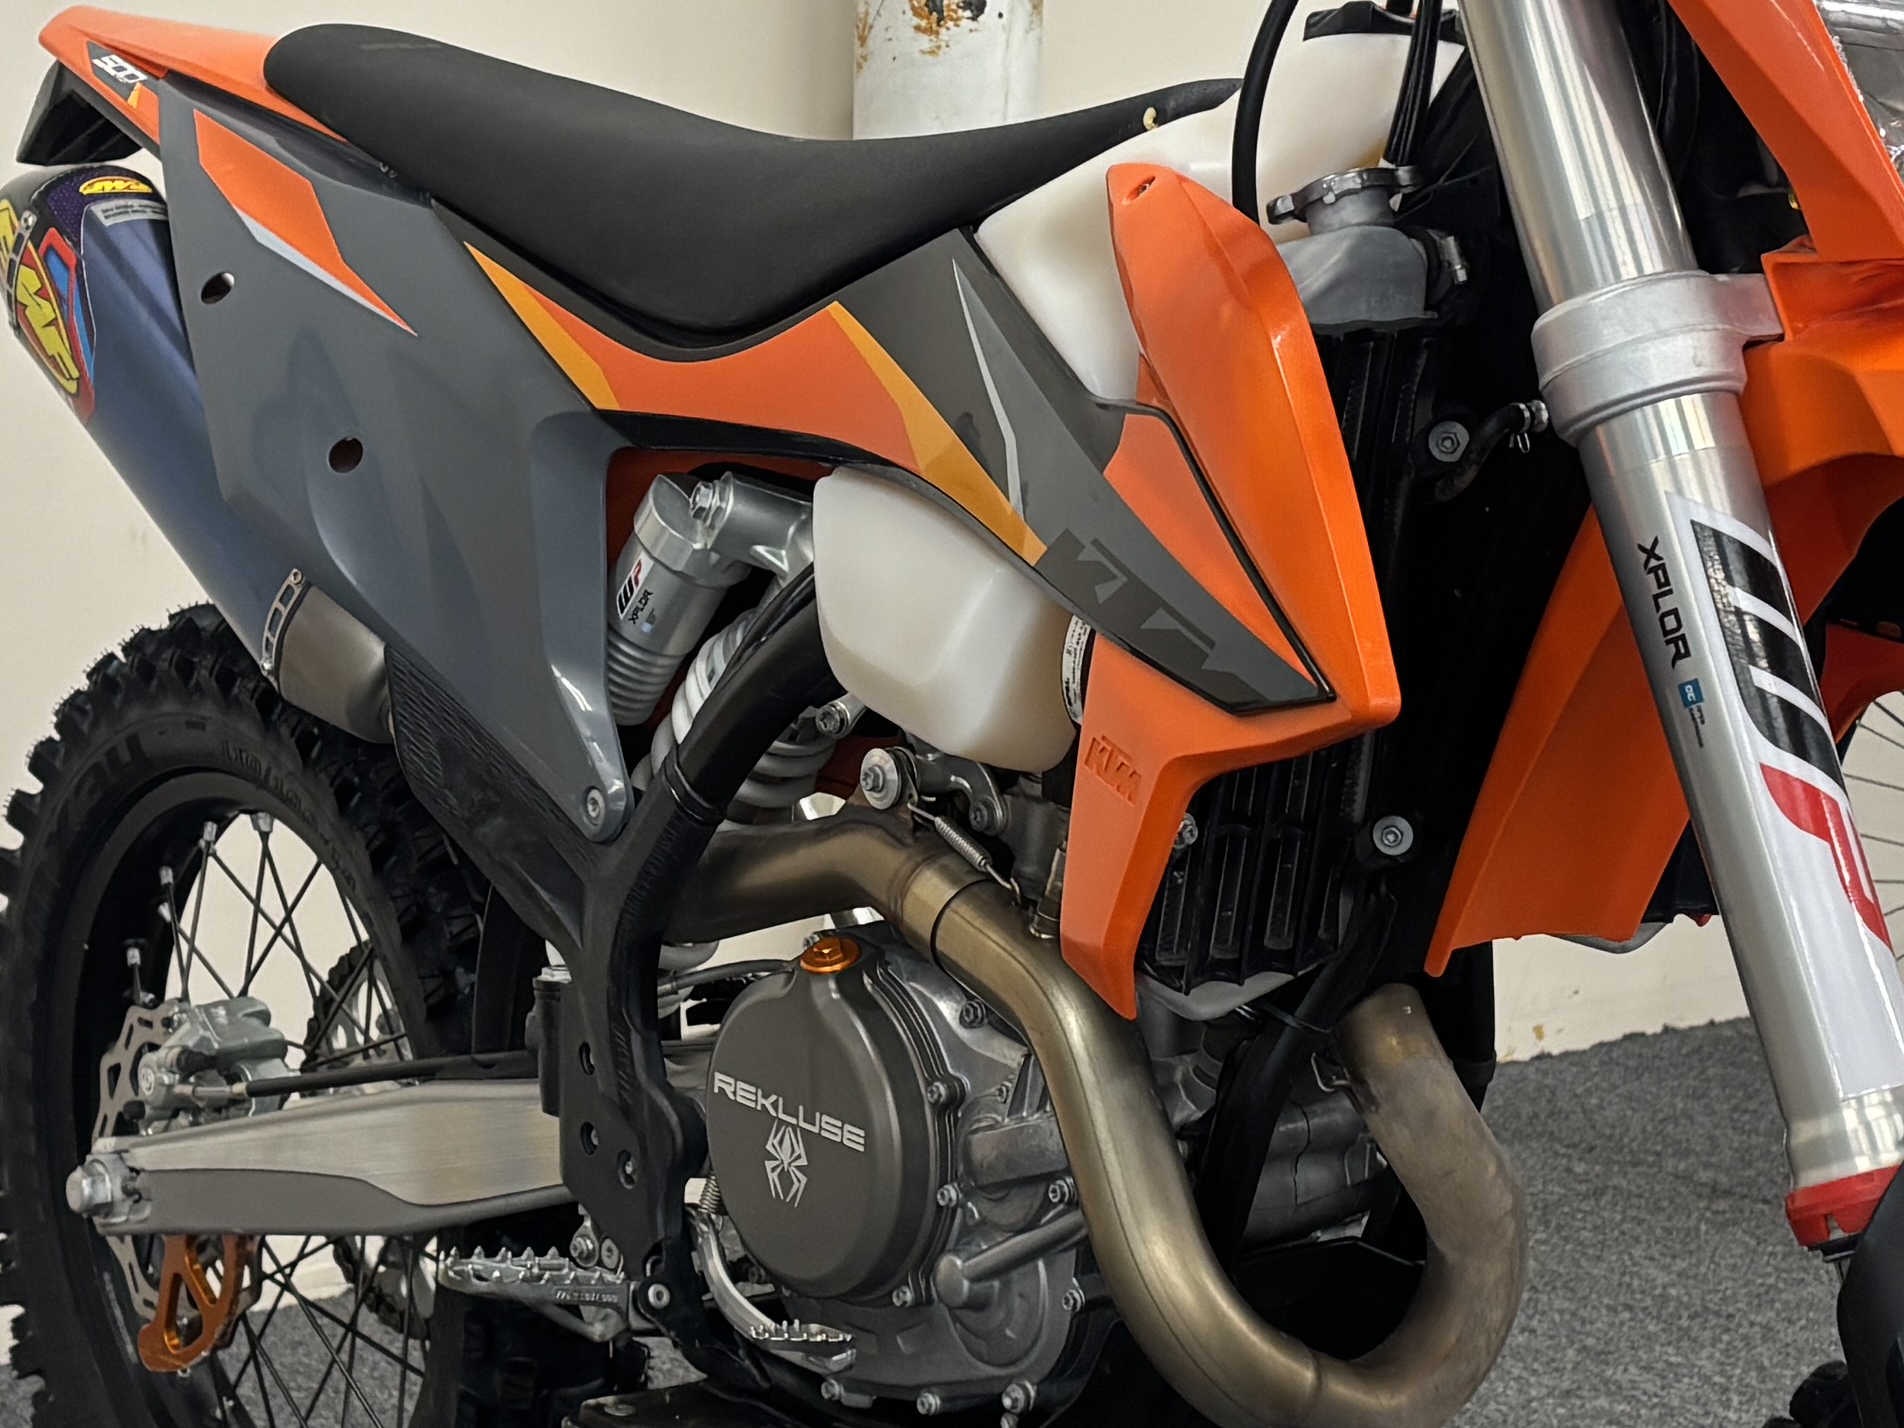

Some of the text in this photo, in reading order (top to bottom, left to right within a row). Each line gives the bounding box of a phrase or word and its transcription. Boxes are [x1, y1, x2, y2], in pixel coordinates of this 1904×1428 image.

[1637, 536, 1691, 669] XPLOR
[1084, 734, 1141, 808] KTM
[713, 1071, 865, 1153] REKLUSE
